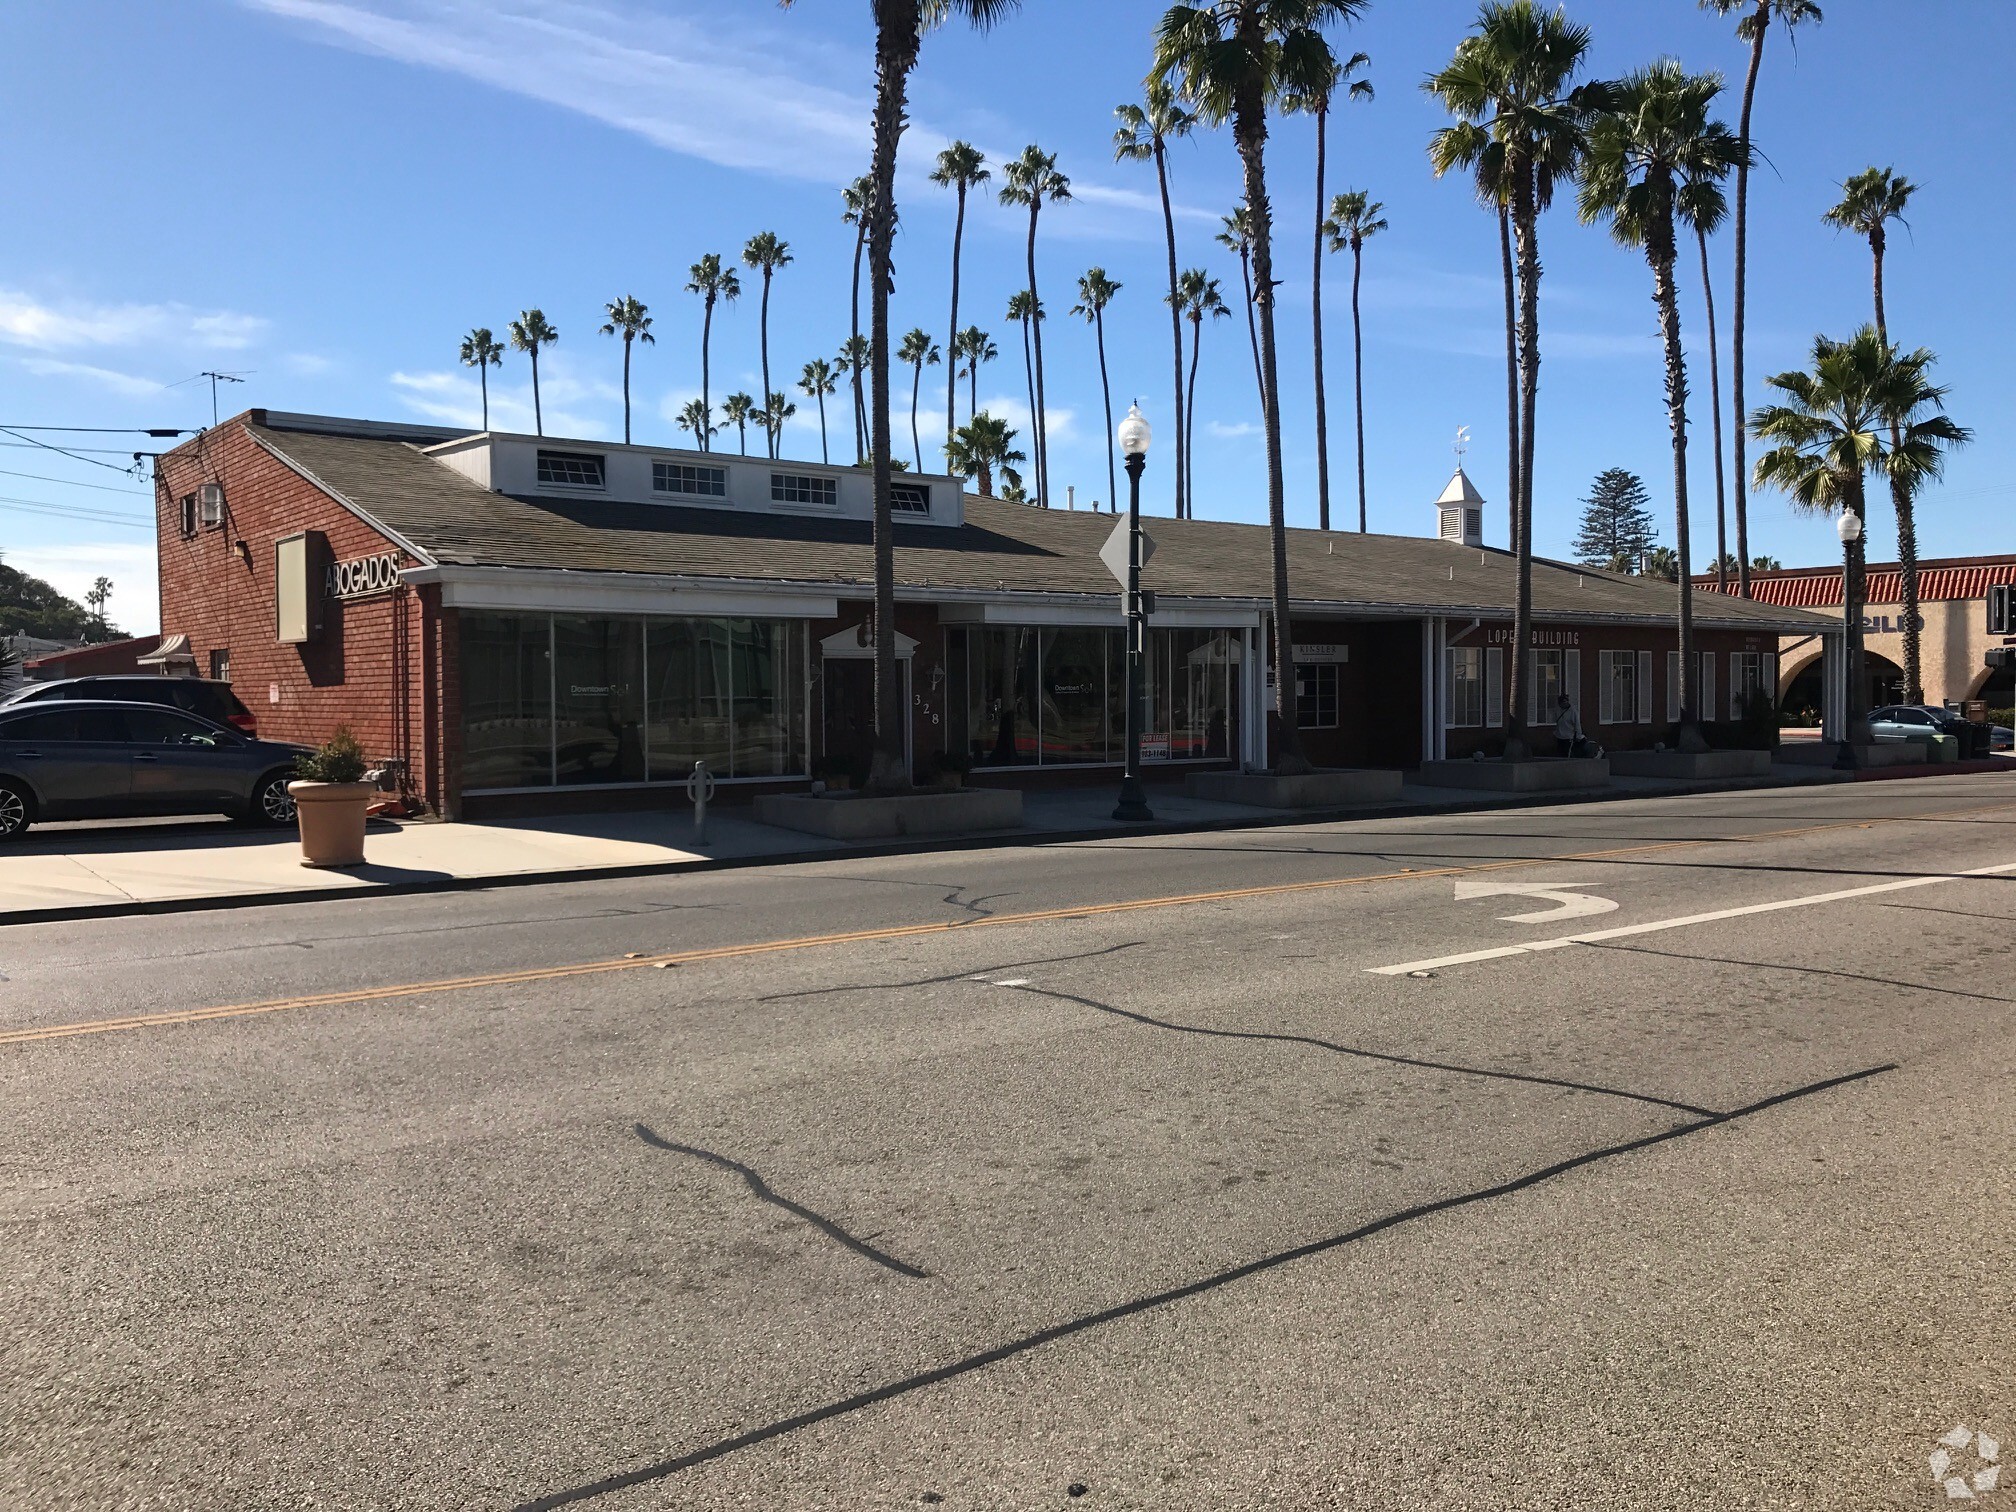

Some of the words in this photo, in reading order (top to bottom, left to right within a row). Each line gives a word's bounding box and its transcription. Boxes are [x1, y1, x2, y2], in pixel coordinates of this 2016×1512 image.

[325, 553, 398, 596] ABOGADOS
[1487, 629, 1515, 643] LOPE
[1532, 630, 1579, 645] BUILDING
[1300, 645, 1336, 653] KINSLER
[570, 685, 609, 693] Downtown
[913, 694, 939, 725] 328
[1153, 734, 1168, 742] LEASE
